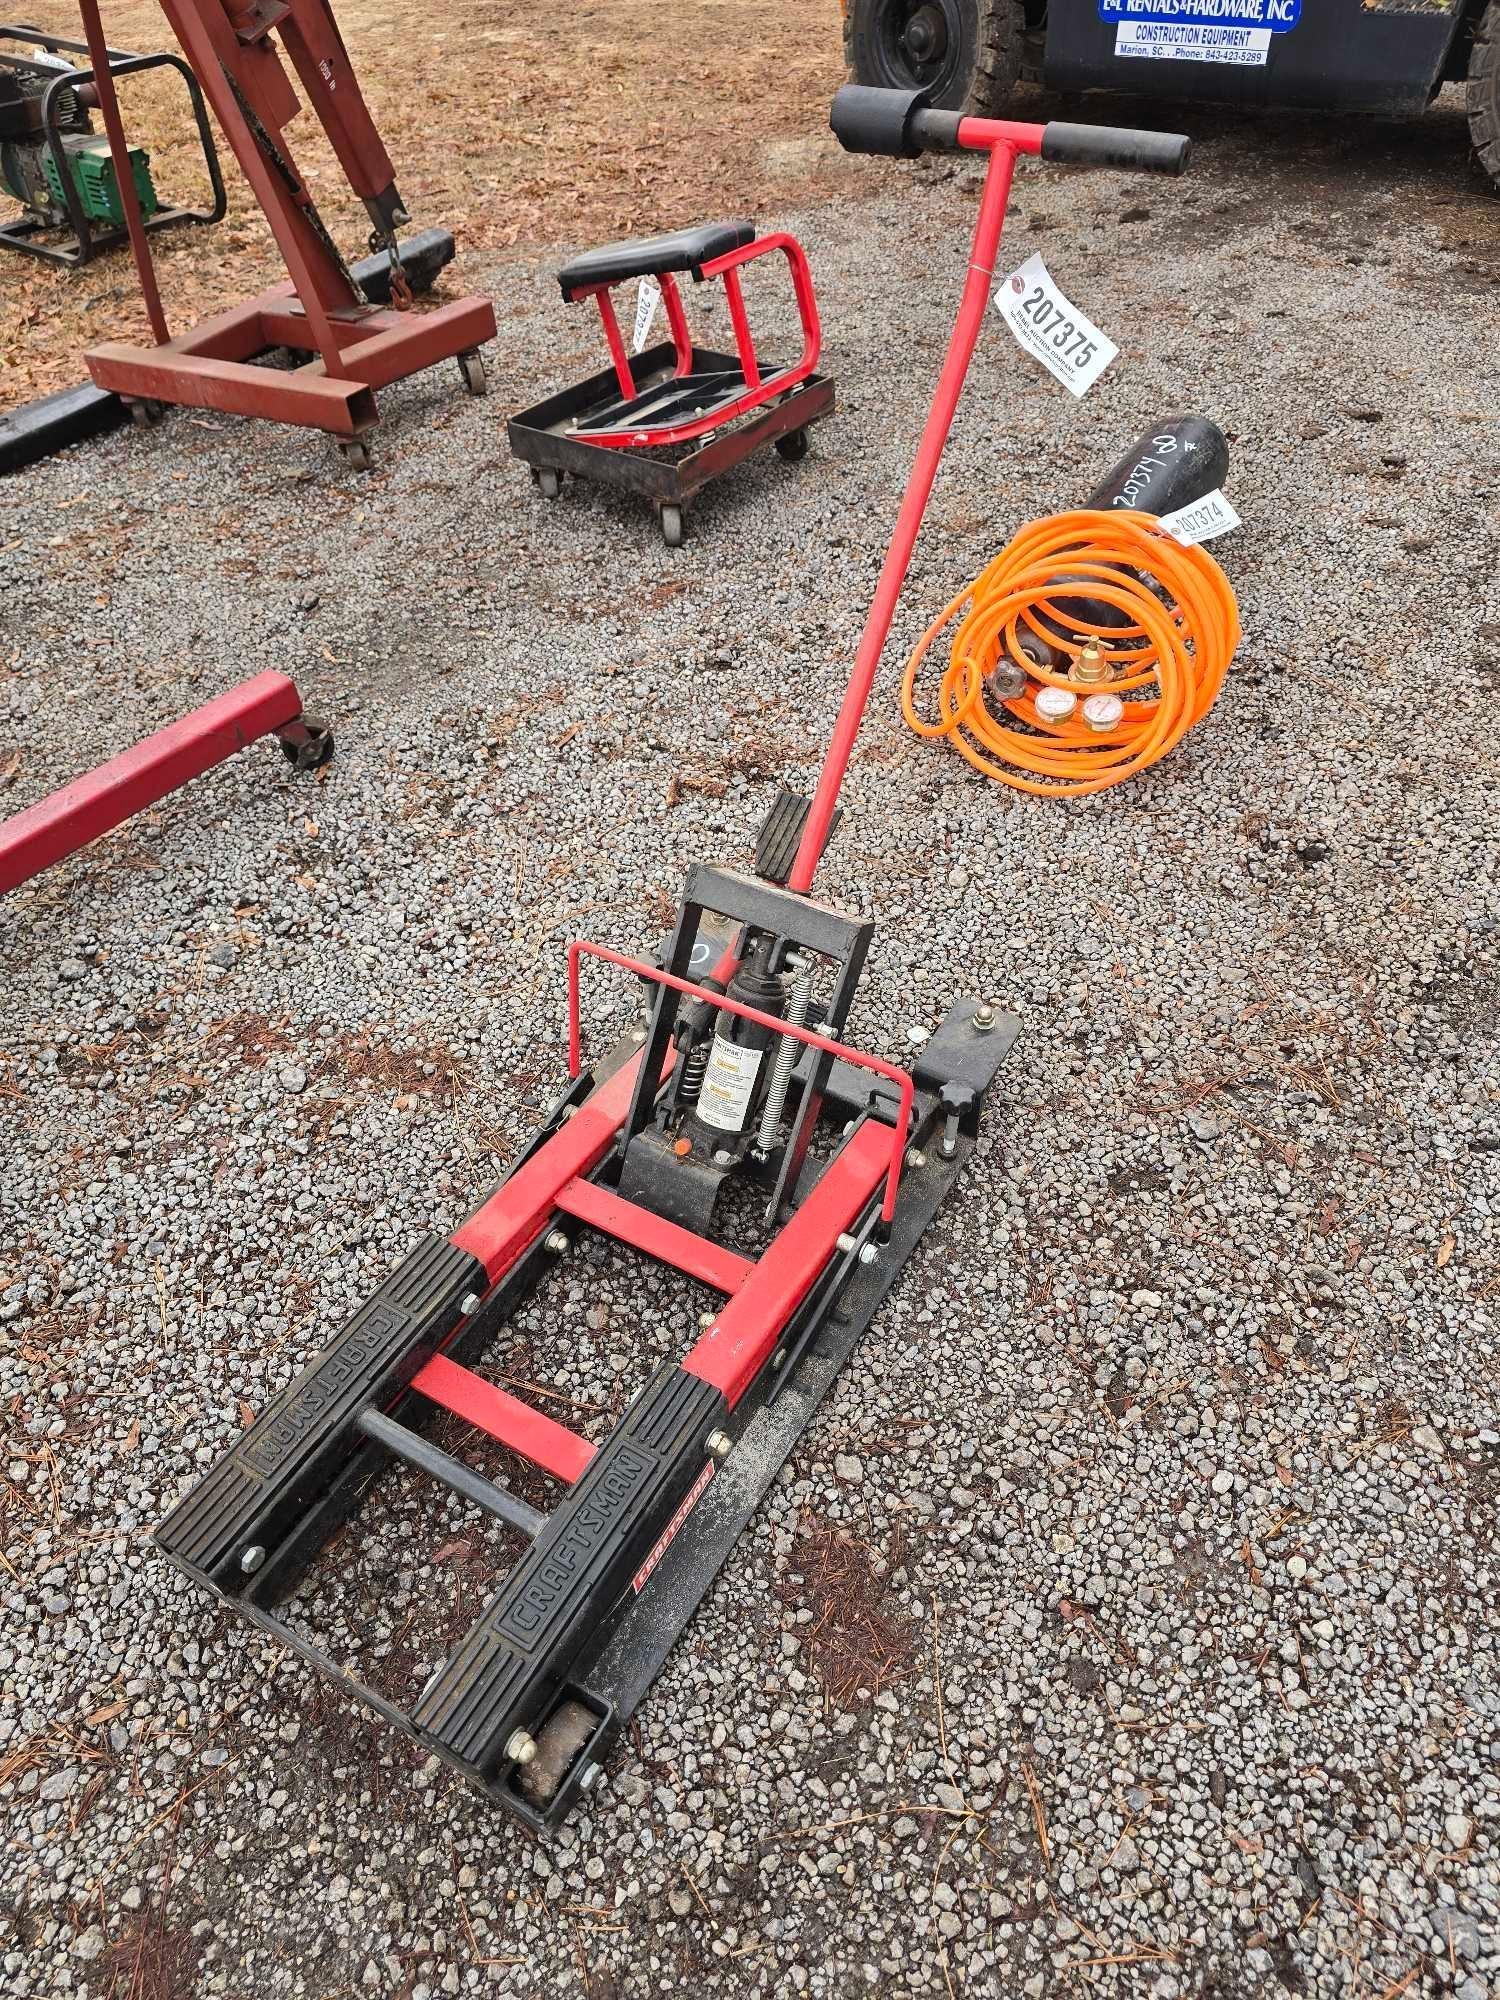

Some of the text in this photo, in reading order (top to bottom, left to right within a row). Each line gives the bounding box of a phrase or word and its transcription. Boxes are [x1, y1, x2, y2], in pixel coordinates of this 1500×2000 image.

[1120, 44, 1149, 57] Marion,
[1136, 24, 1252, 47] CONSTRUCTION EQUIPMENT
[1022, 286, 1098, 368] 207375
[1176, 501, 1224, 532] 207374
[255, 1314, 394, 1463] CRAFTSMAN
[511, 1453, 644, 1631] CRAFTSMAN
[638, 1465, 710, 1585] CRAFTSMAN
